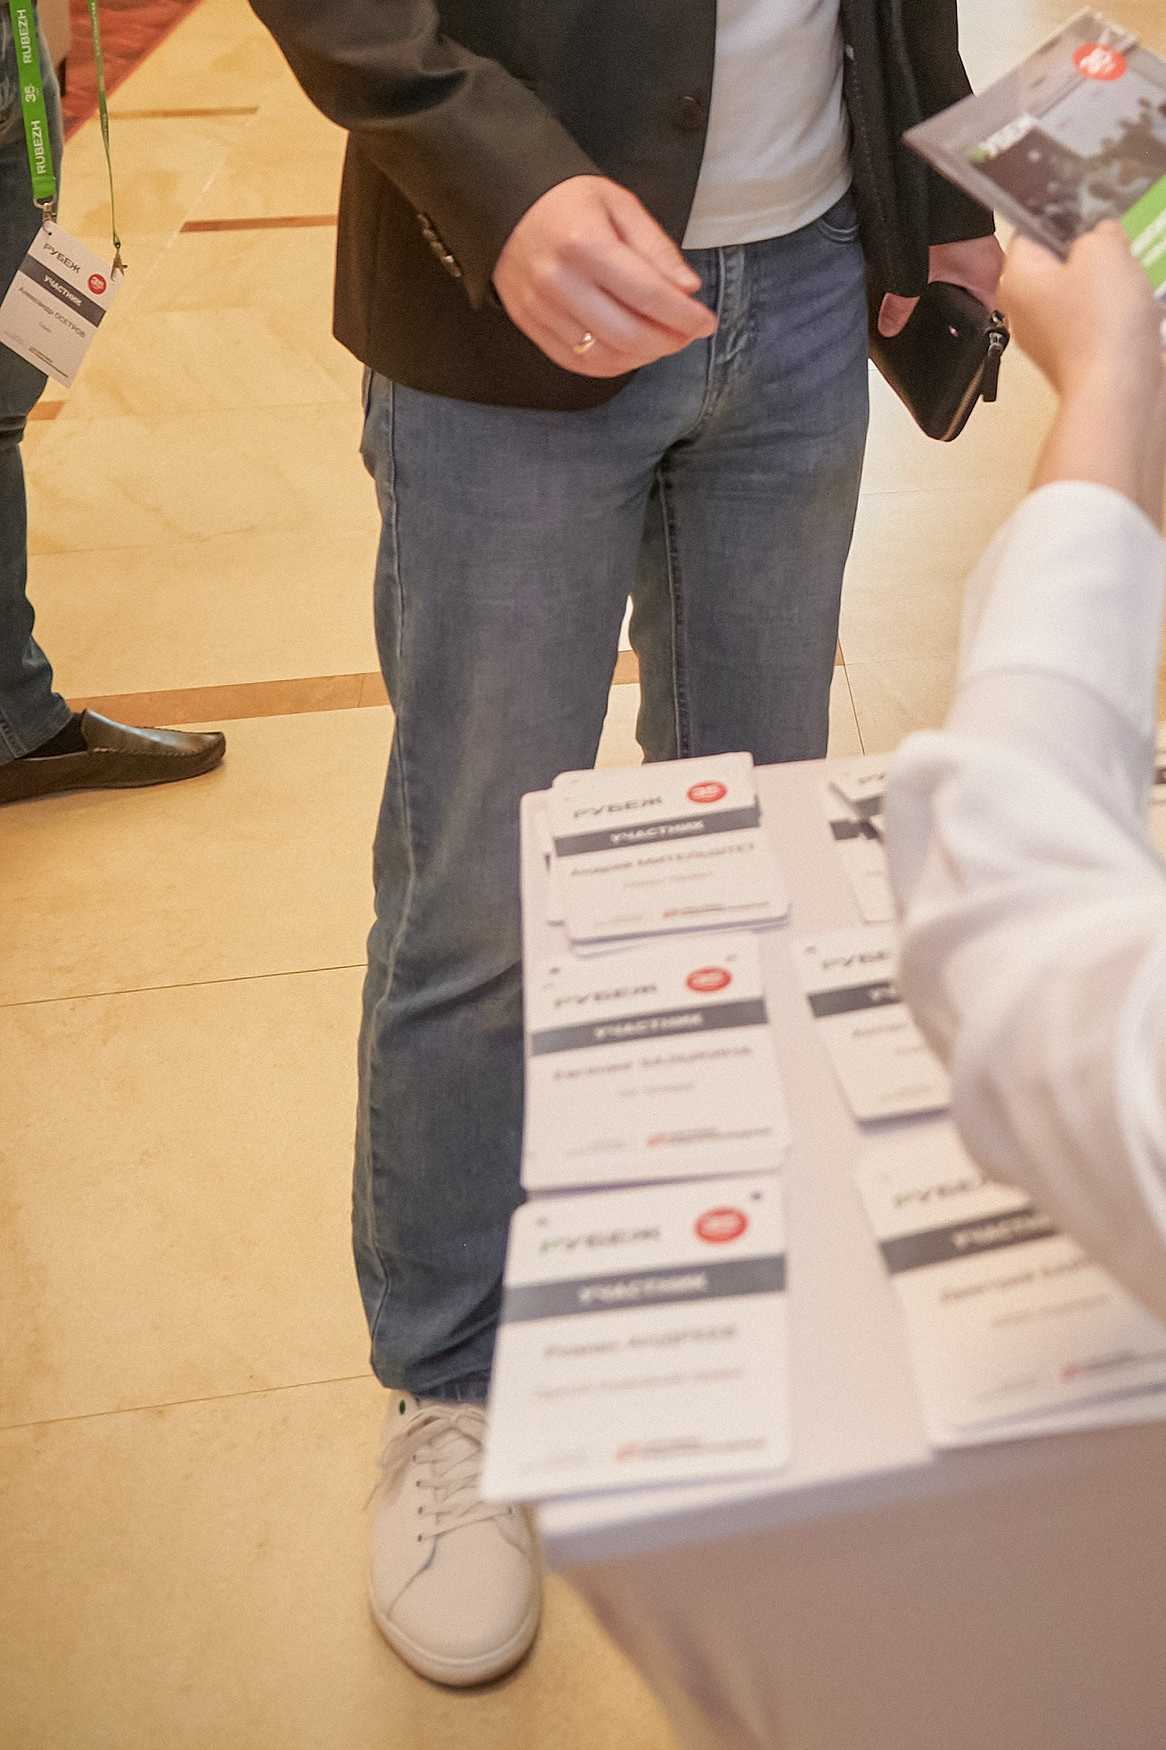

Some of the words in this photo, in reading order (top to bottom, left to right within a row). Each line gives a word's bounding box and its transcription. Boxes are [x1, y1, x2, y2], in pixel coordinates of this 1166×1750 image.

[17, 9, 32, 64] RUBEZH
[24, 84, 37, 103] 35
[31, 120, 46, 174] RUBEZH
[43, 243, 81, 274] РУБЕЖ
[43, 274, 83, 307] УЧАСТНИК
